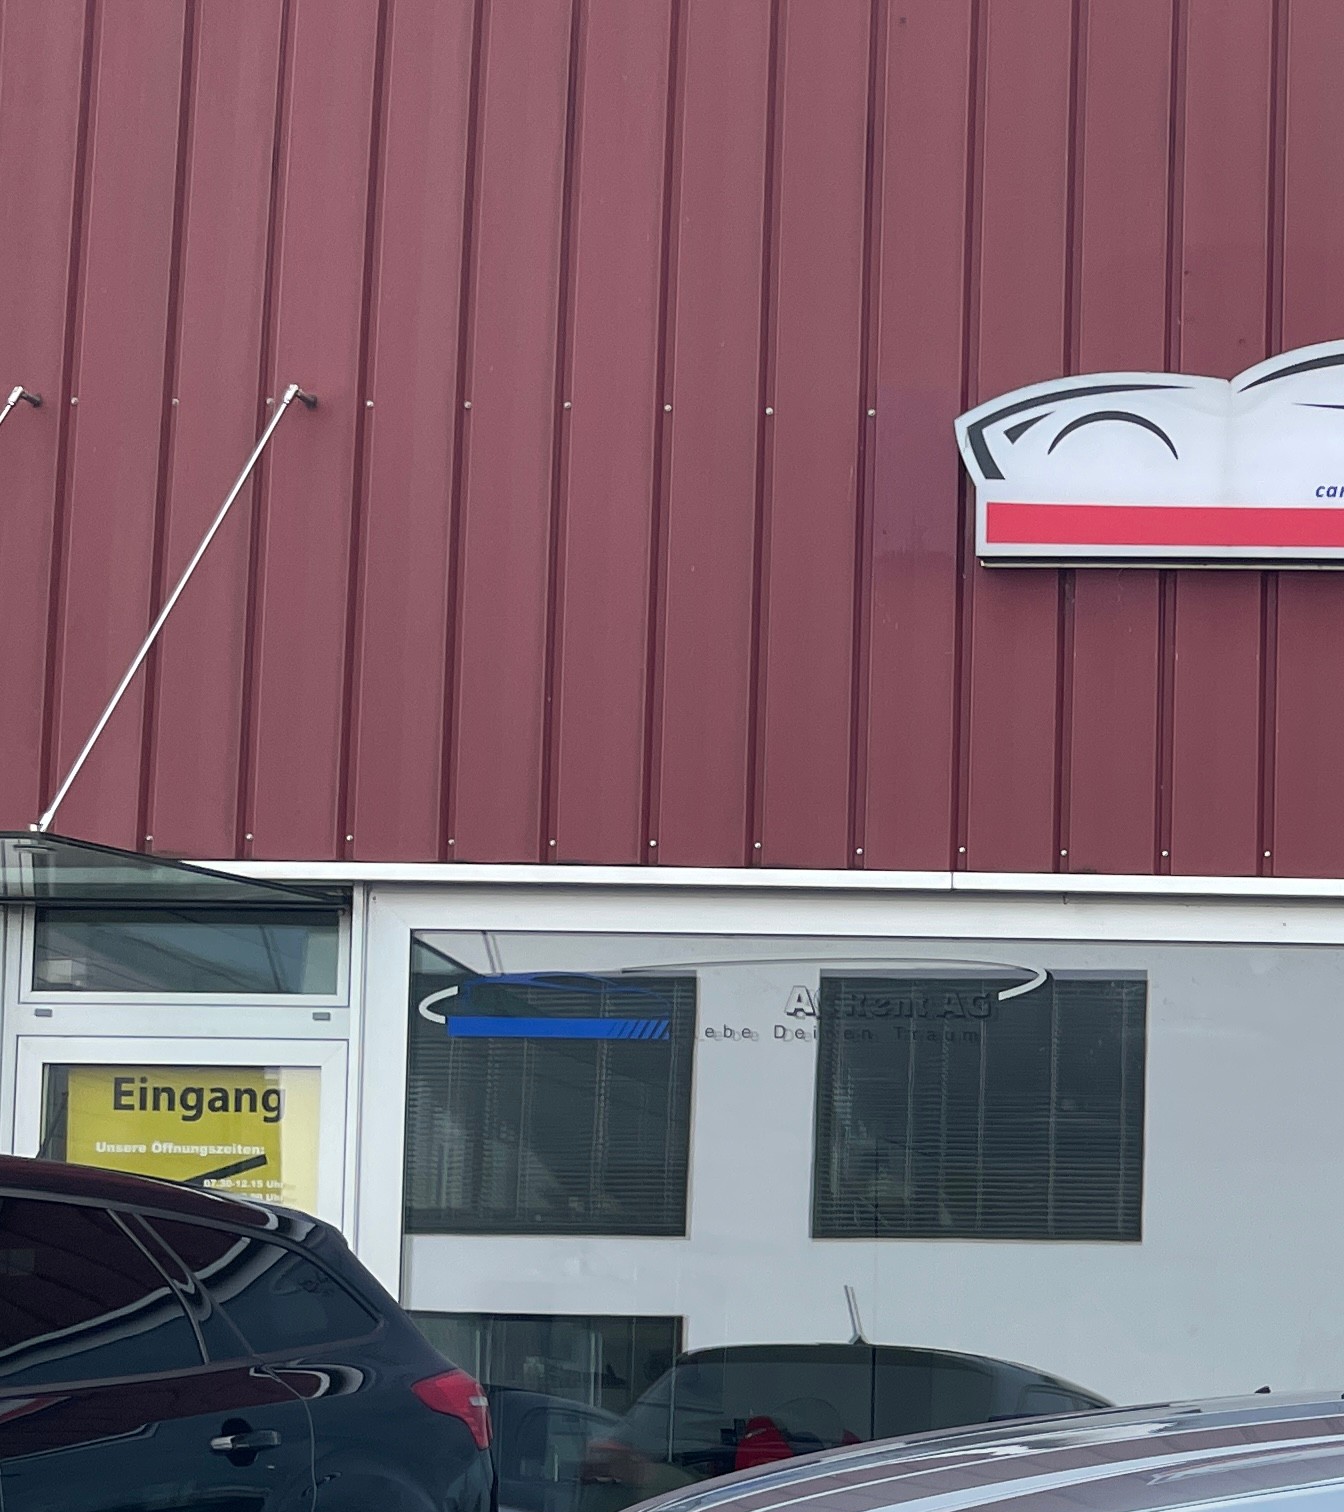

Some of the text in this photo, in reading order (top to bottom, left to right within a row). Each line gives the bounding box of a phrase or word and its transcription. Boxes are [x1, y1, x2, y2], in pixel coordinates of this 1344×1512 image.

[112, 1076, 285, 1123] Eingang
[95, 1140, 265, 1157] Unsere Öffnungszeiten:
